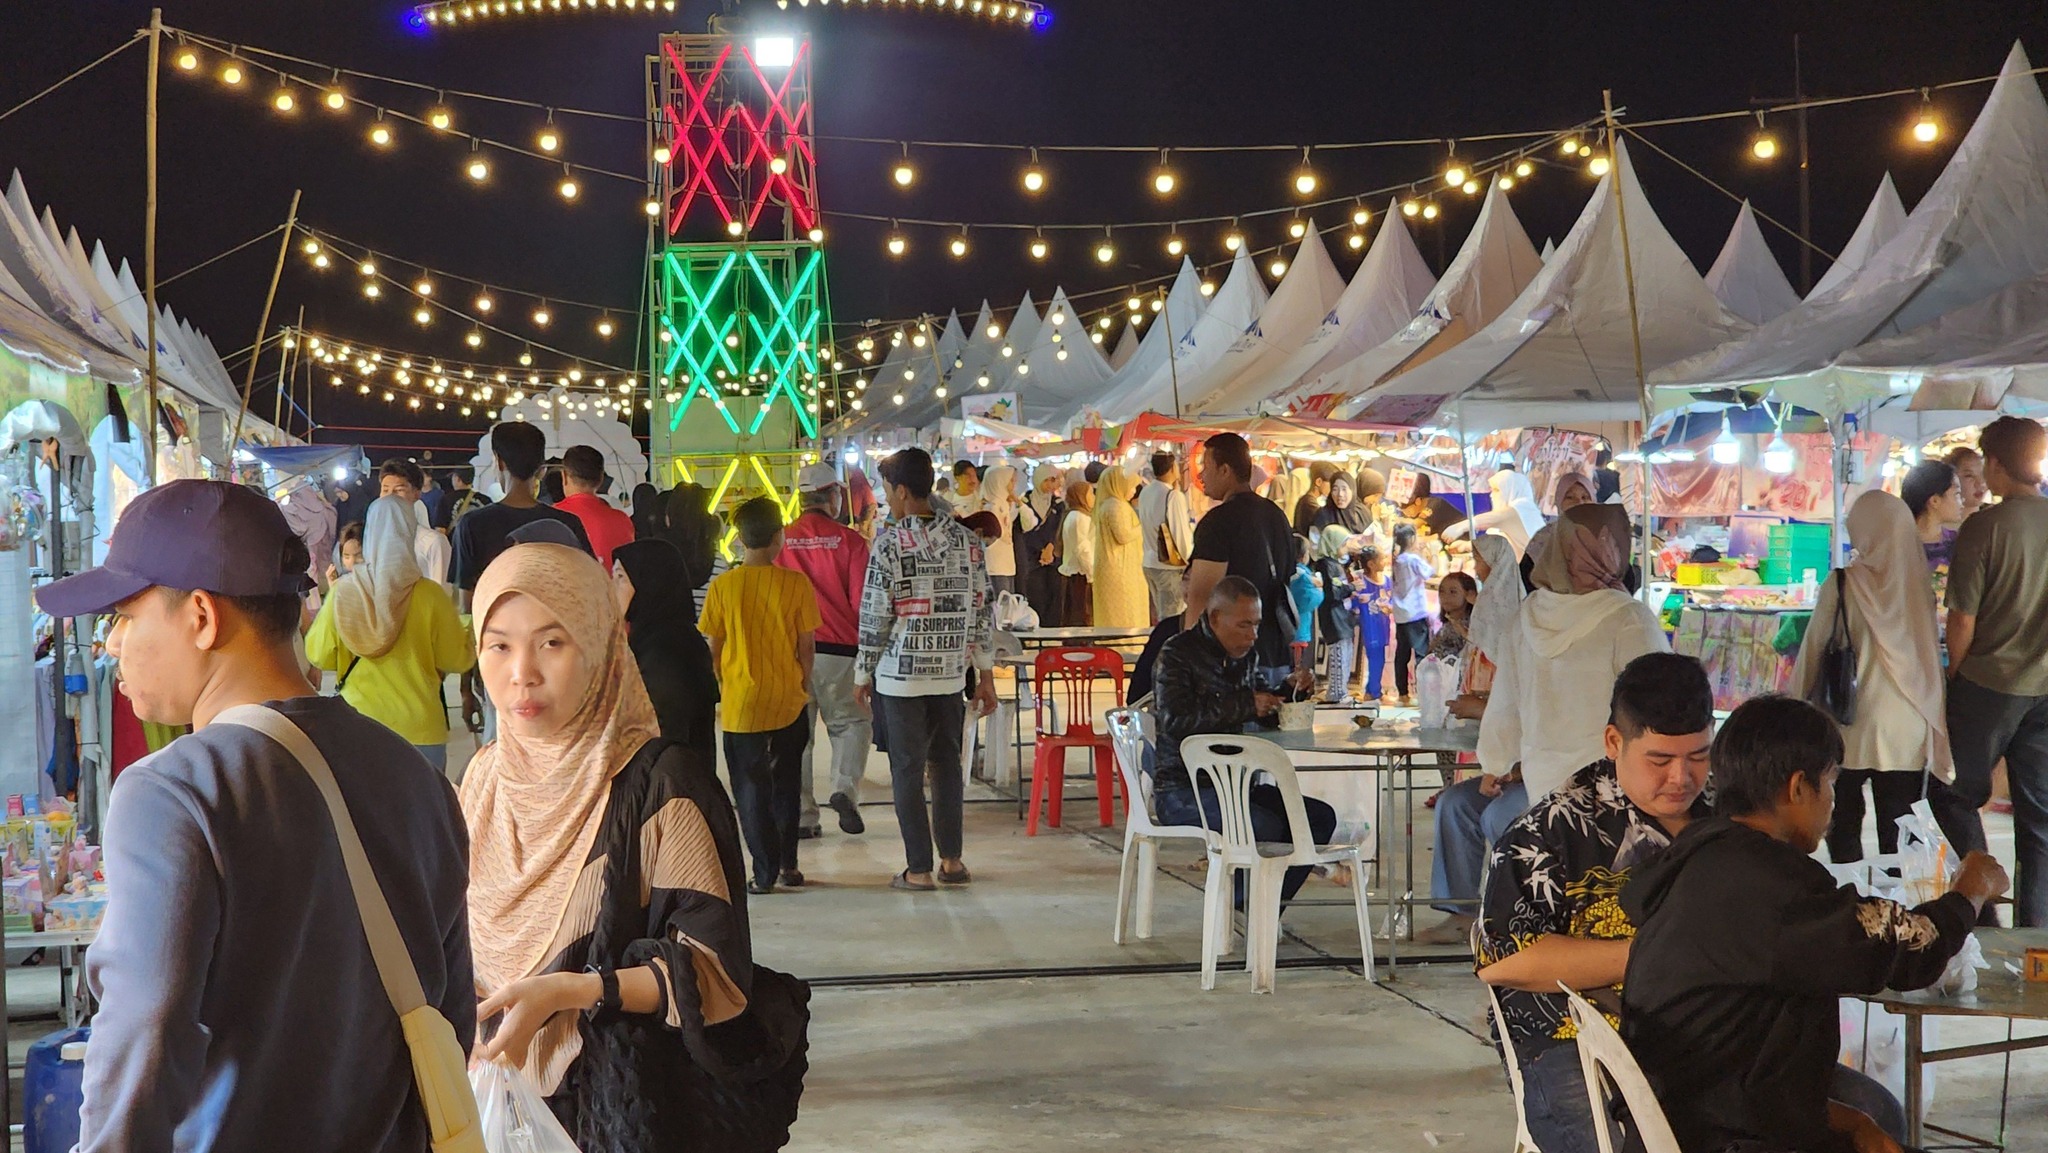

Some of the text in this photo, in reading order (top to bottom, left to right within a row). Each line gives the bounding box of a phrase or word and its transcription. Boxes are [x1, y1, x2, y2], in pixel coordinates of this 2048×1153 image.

[918, 566, 945, 575] FANTASY
[923, 616, 966, 631] SURPRISE
[902, 635, 965, 649] ALL IS READY
[914, 666, 944, 675] FANTASY
